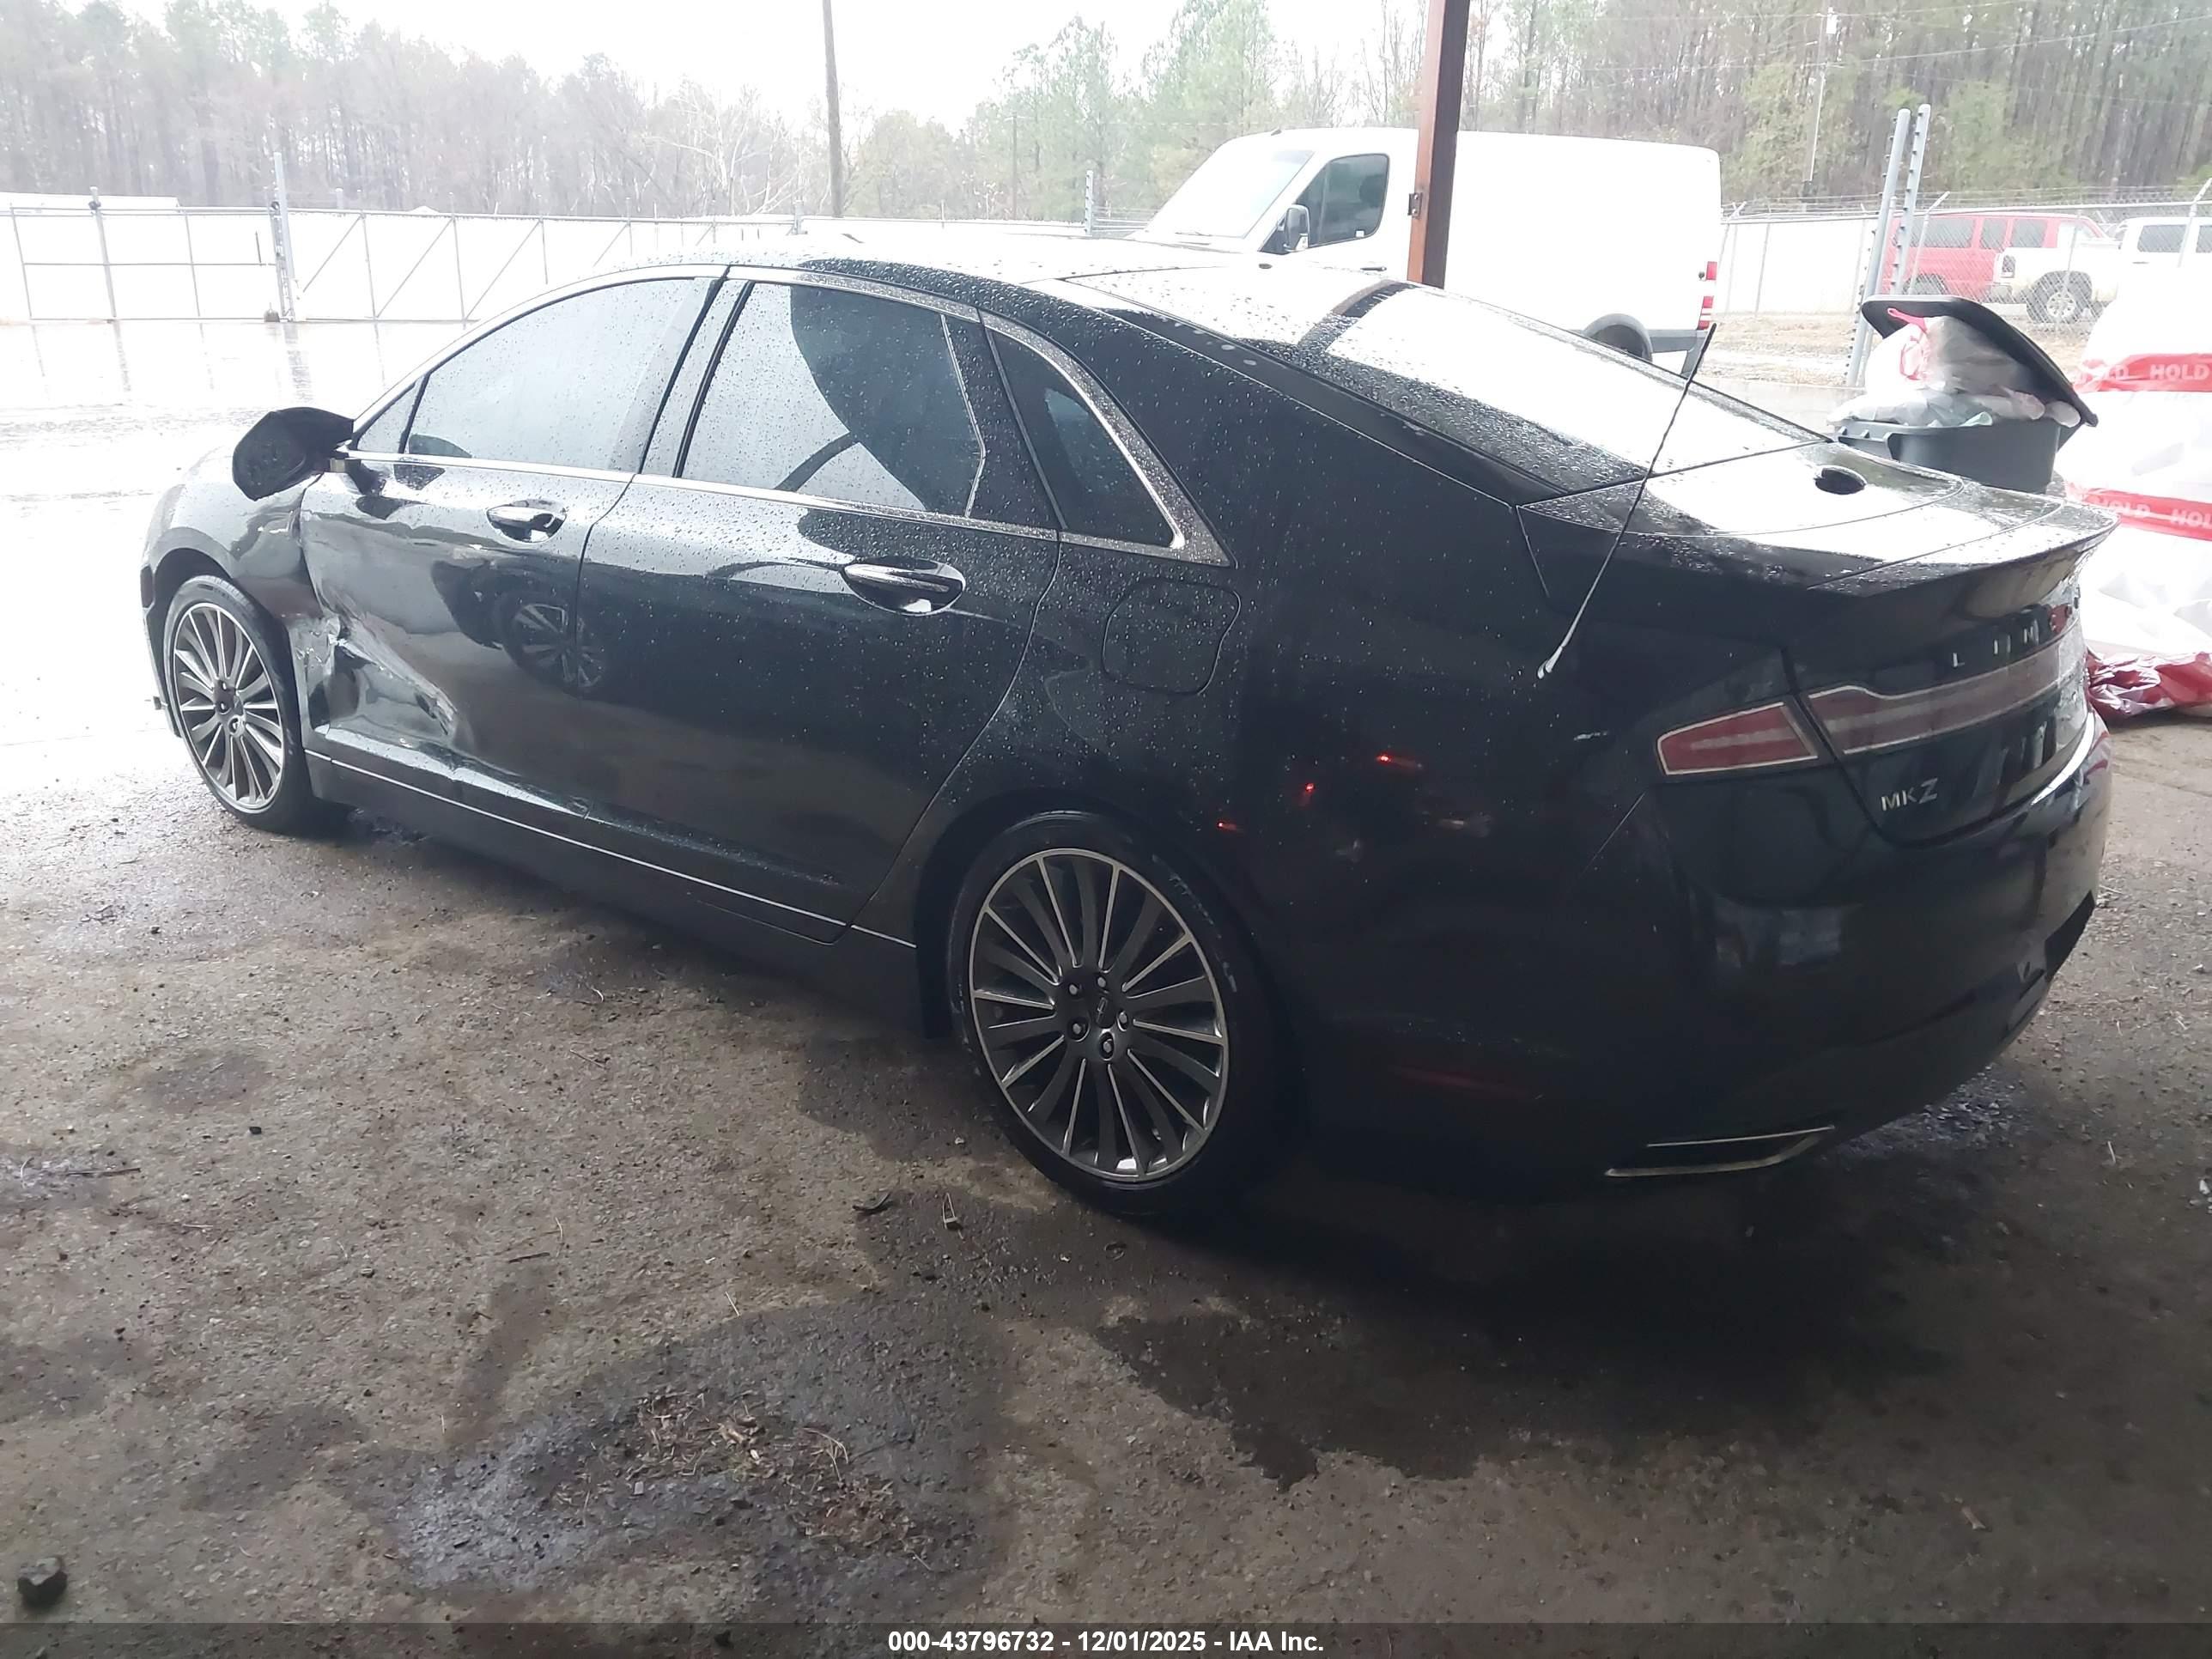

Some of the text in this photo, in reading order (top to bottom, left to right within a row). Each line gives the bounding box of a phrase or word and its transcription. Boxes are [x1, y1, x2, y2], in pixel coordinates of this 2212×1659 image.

[2149, 364, 2210, 380] HOLD
[1952, 594, 2079, 668] LINC
[1881, 777, 1938, 811] MKZ
